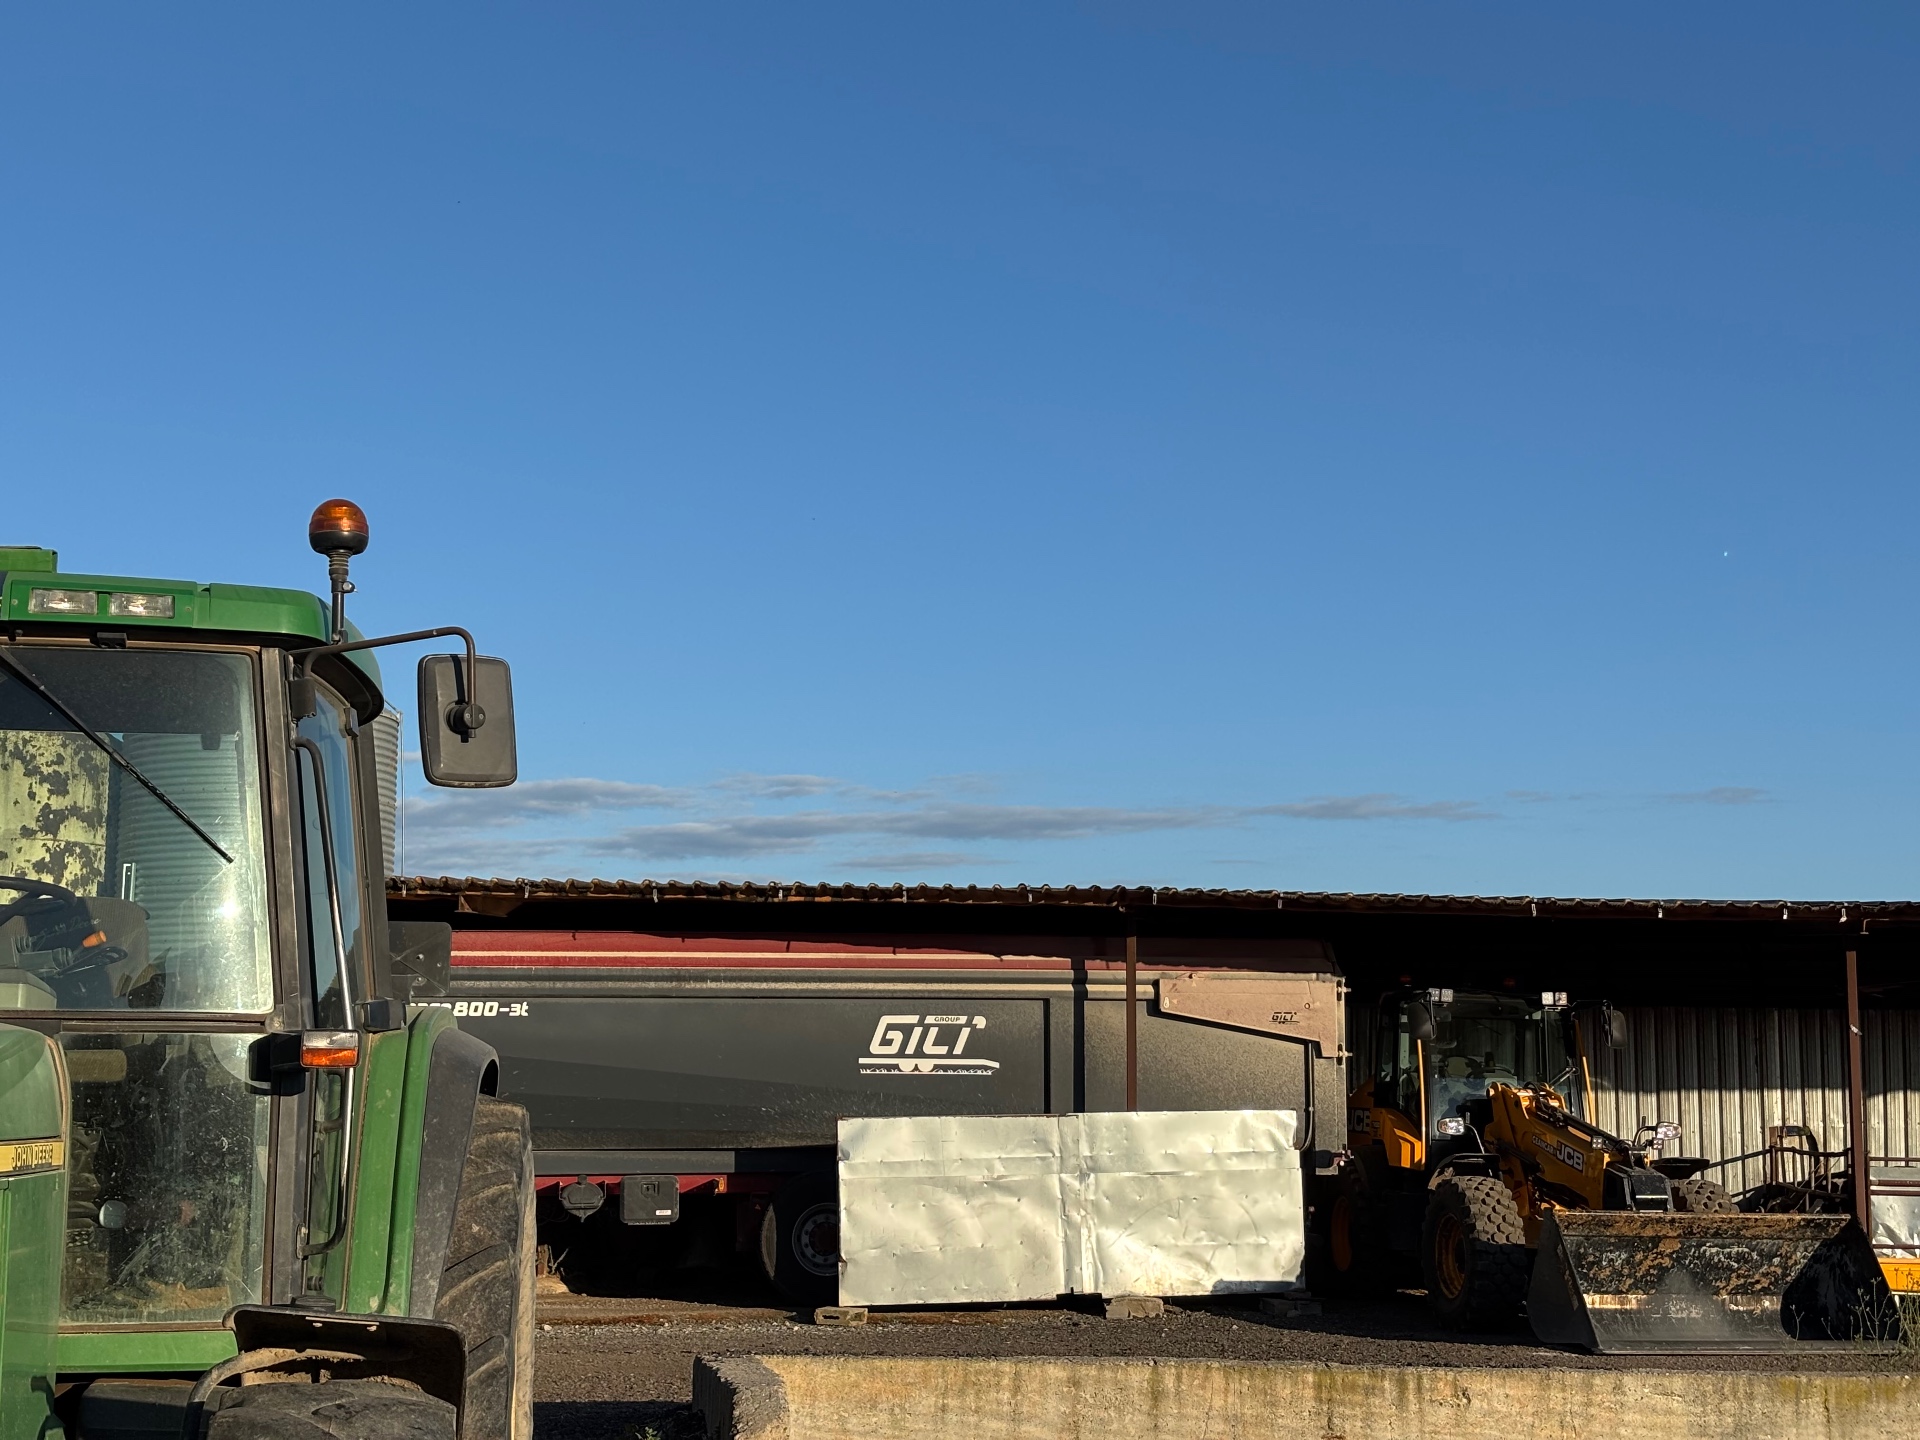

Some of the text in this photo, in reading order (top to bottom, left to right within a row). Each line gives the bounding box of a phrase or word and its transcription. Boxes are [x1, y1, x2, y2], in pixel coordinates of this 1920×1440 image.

[12, 1143, 54, 1170] JOHN DEERE
[1556, 1141, 1584, 1171] JCB
